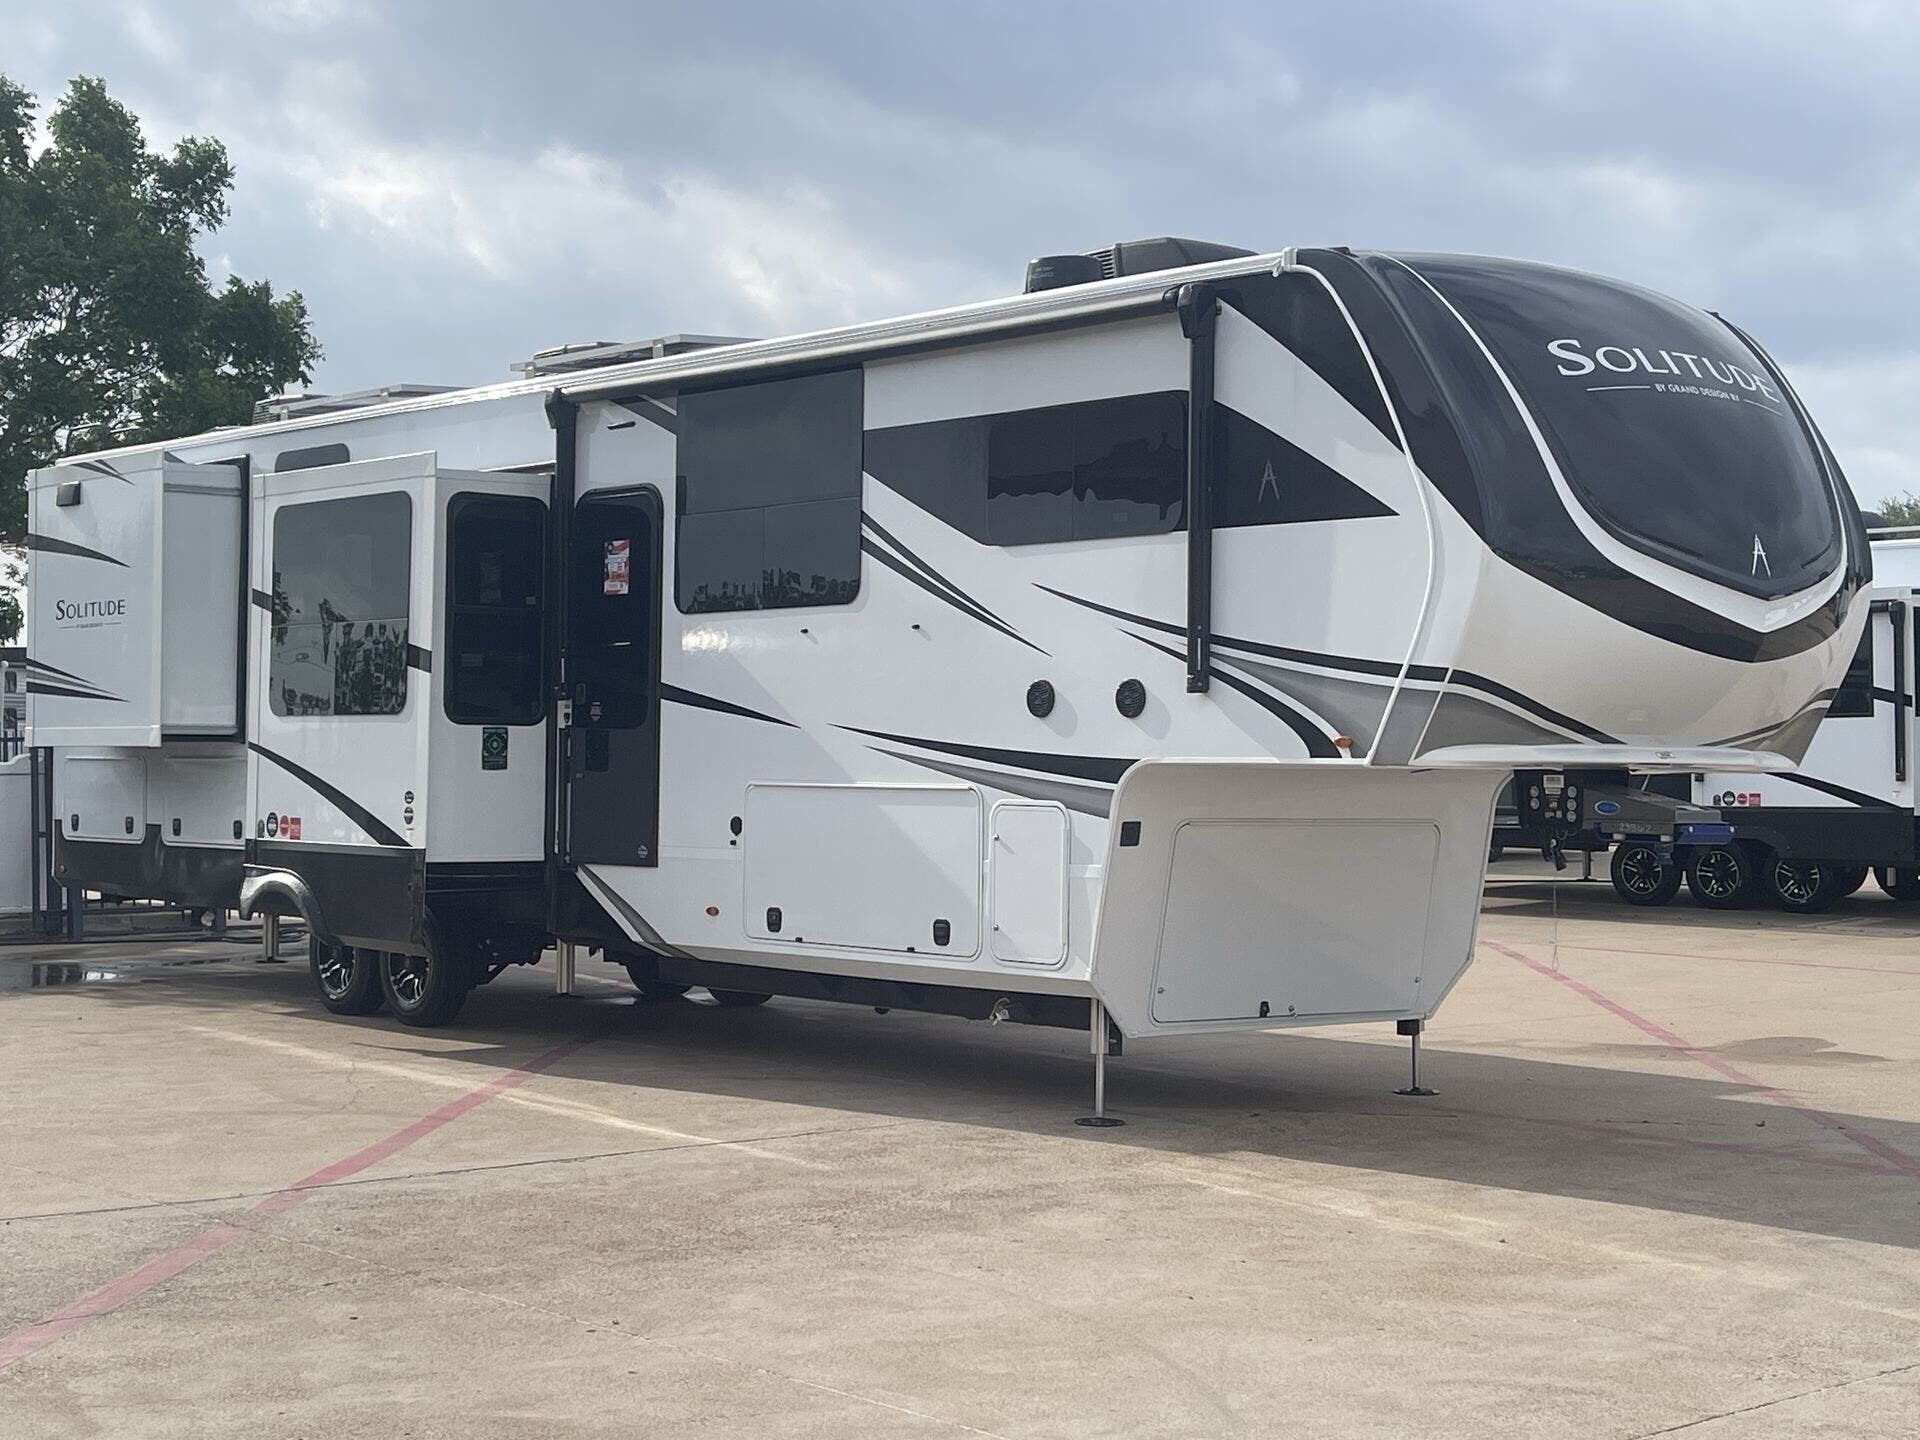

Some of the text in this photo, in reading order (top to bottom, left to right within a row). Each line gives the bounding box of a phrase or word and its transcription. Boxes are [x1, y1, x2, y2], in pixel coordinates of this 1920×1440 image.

[1547, 338, 1780, 403] SOLITUDE
[1654, 383, 1667, 392] BY
[1667, 383, 1700, 395] GRAND
[1699, 387, 1731, 400] DESIGN
[55, 599, 126, 621] SOLITUDE
